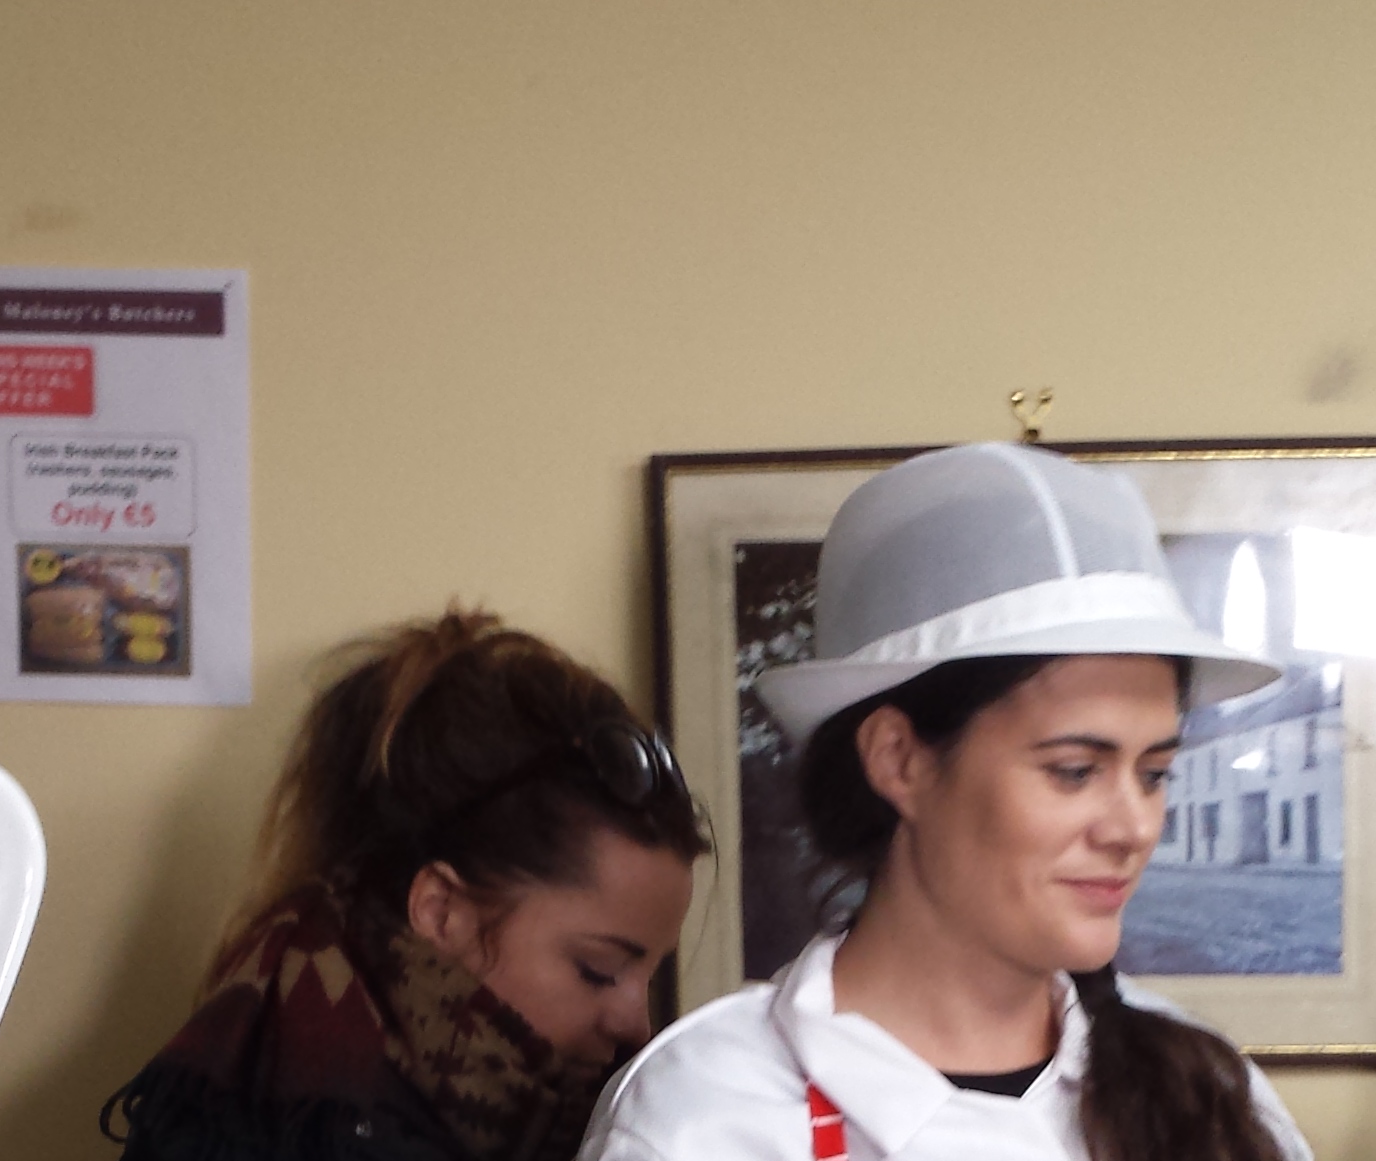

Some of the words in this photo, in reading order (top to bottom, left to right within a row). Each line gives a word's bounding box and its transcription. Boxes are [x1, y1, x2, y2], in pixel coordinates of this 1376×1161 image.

[108, 302, 196, 323] Butchers
[51, 500, 116, 533] Only
[123, 501, 157, 528] €5
